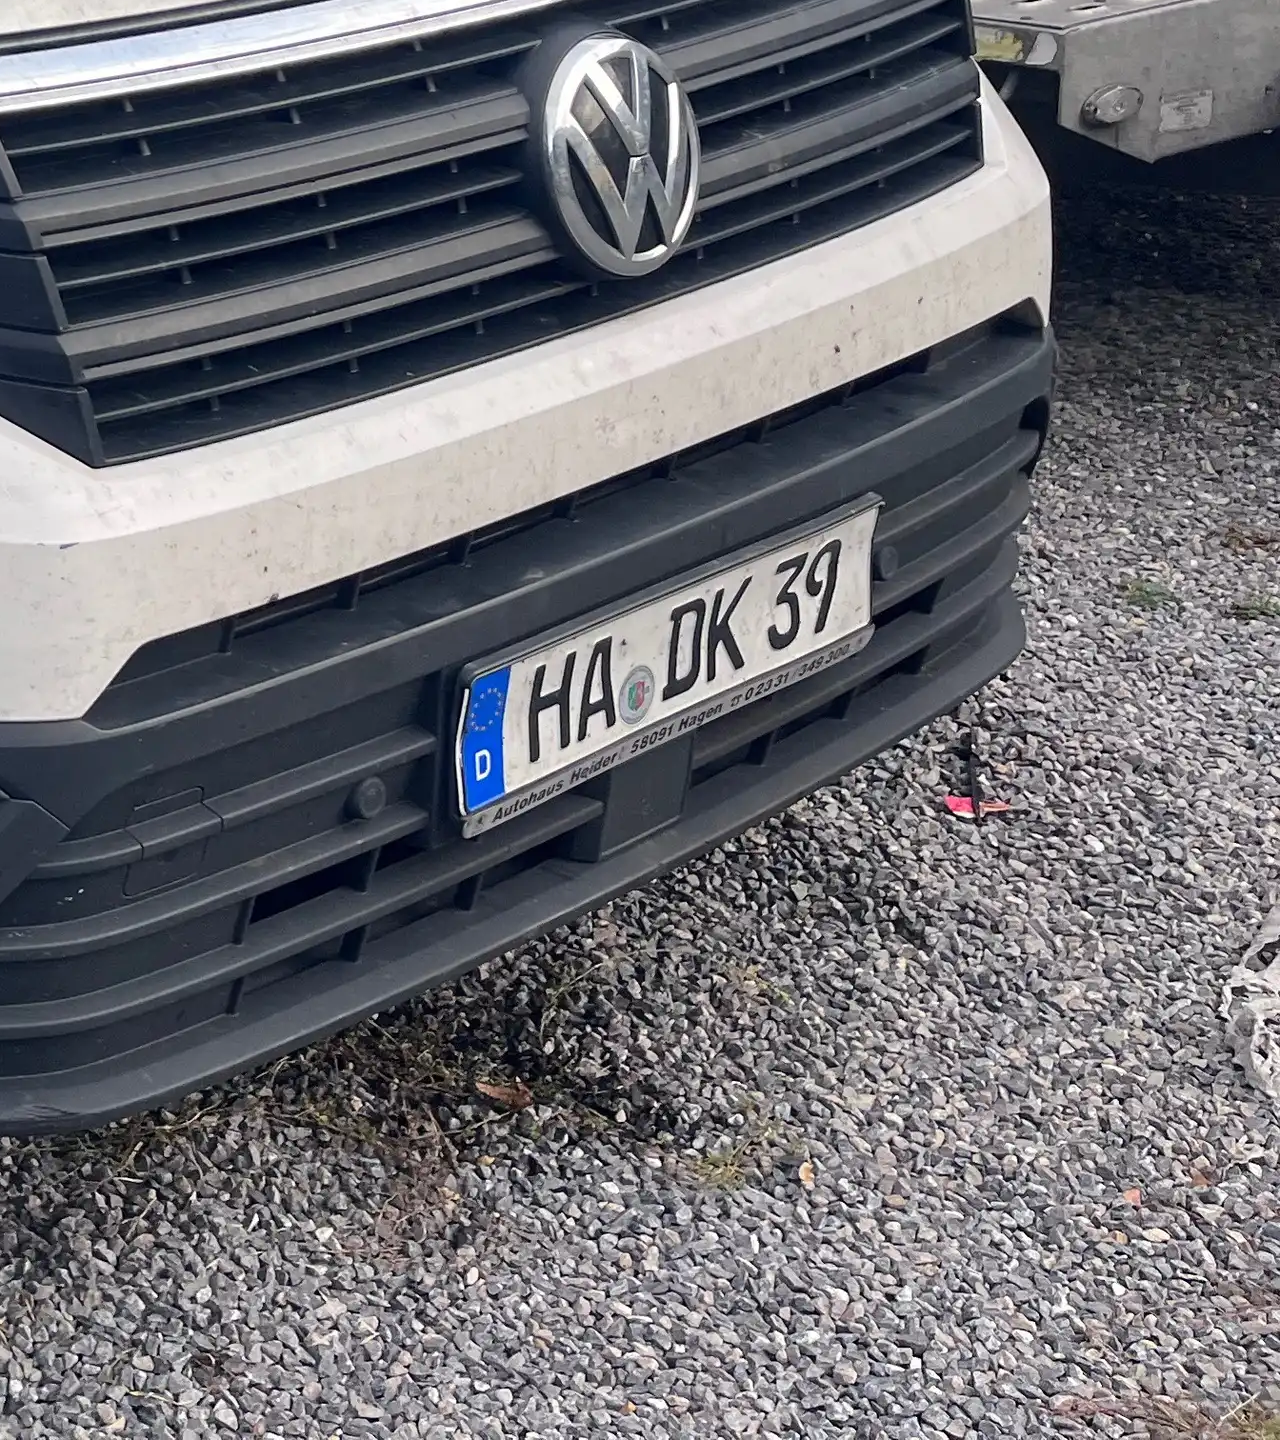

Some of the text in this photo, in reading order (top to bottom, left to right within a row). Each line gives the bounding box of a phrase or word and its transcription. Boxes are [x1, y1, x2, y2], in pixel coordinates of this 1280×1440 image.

[529, 540, 842, 763] HA DK 39
[474, 749, 492, 782] D
[492, 779, 565, 824] Autohaus
[630, 723, 675, 755] 58091
[677, 702, 723, 733] Hagen
